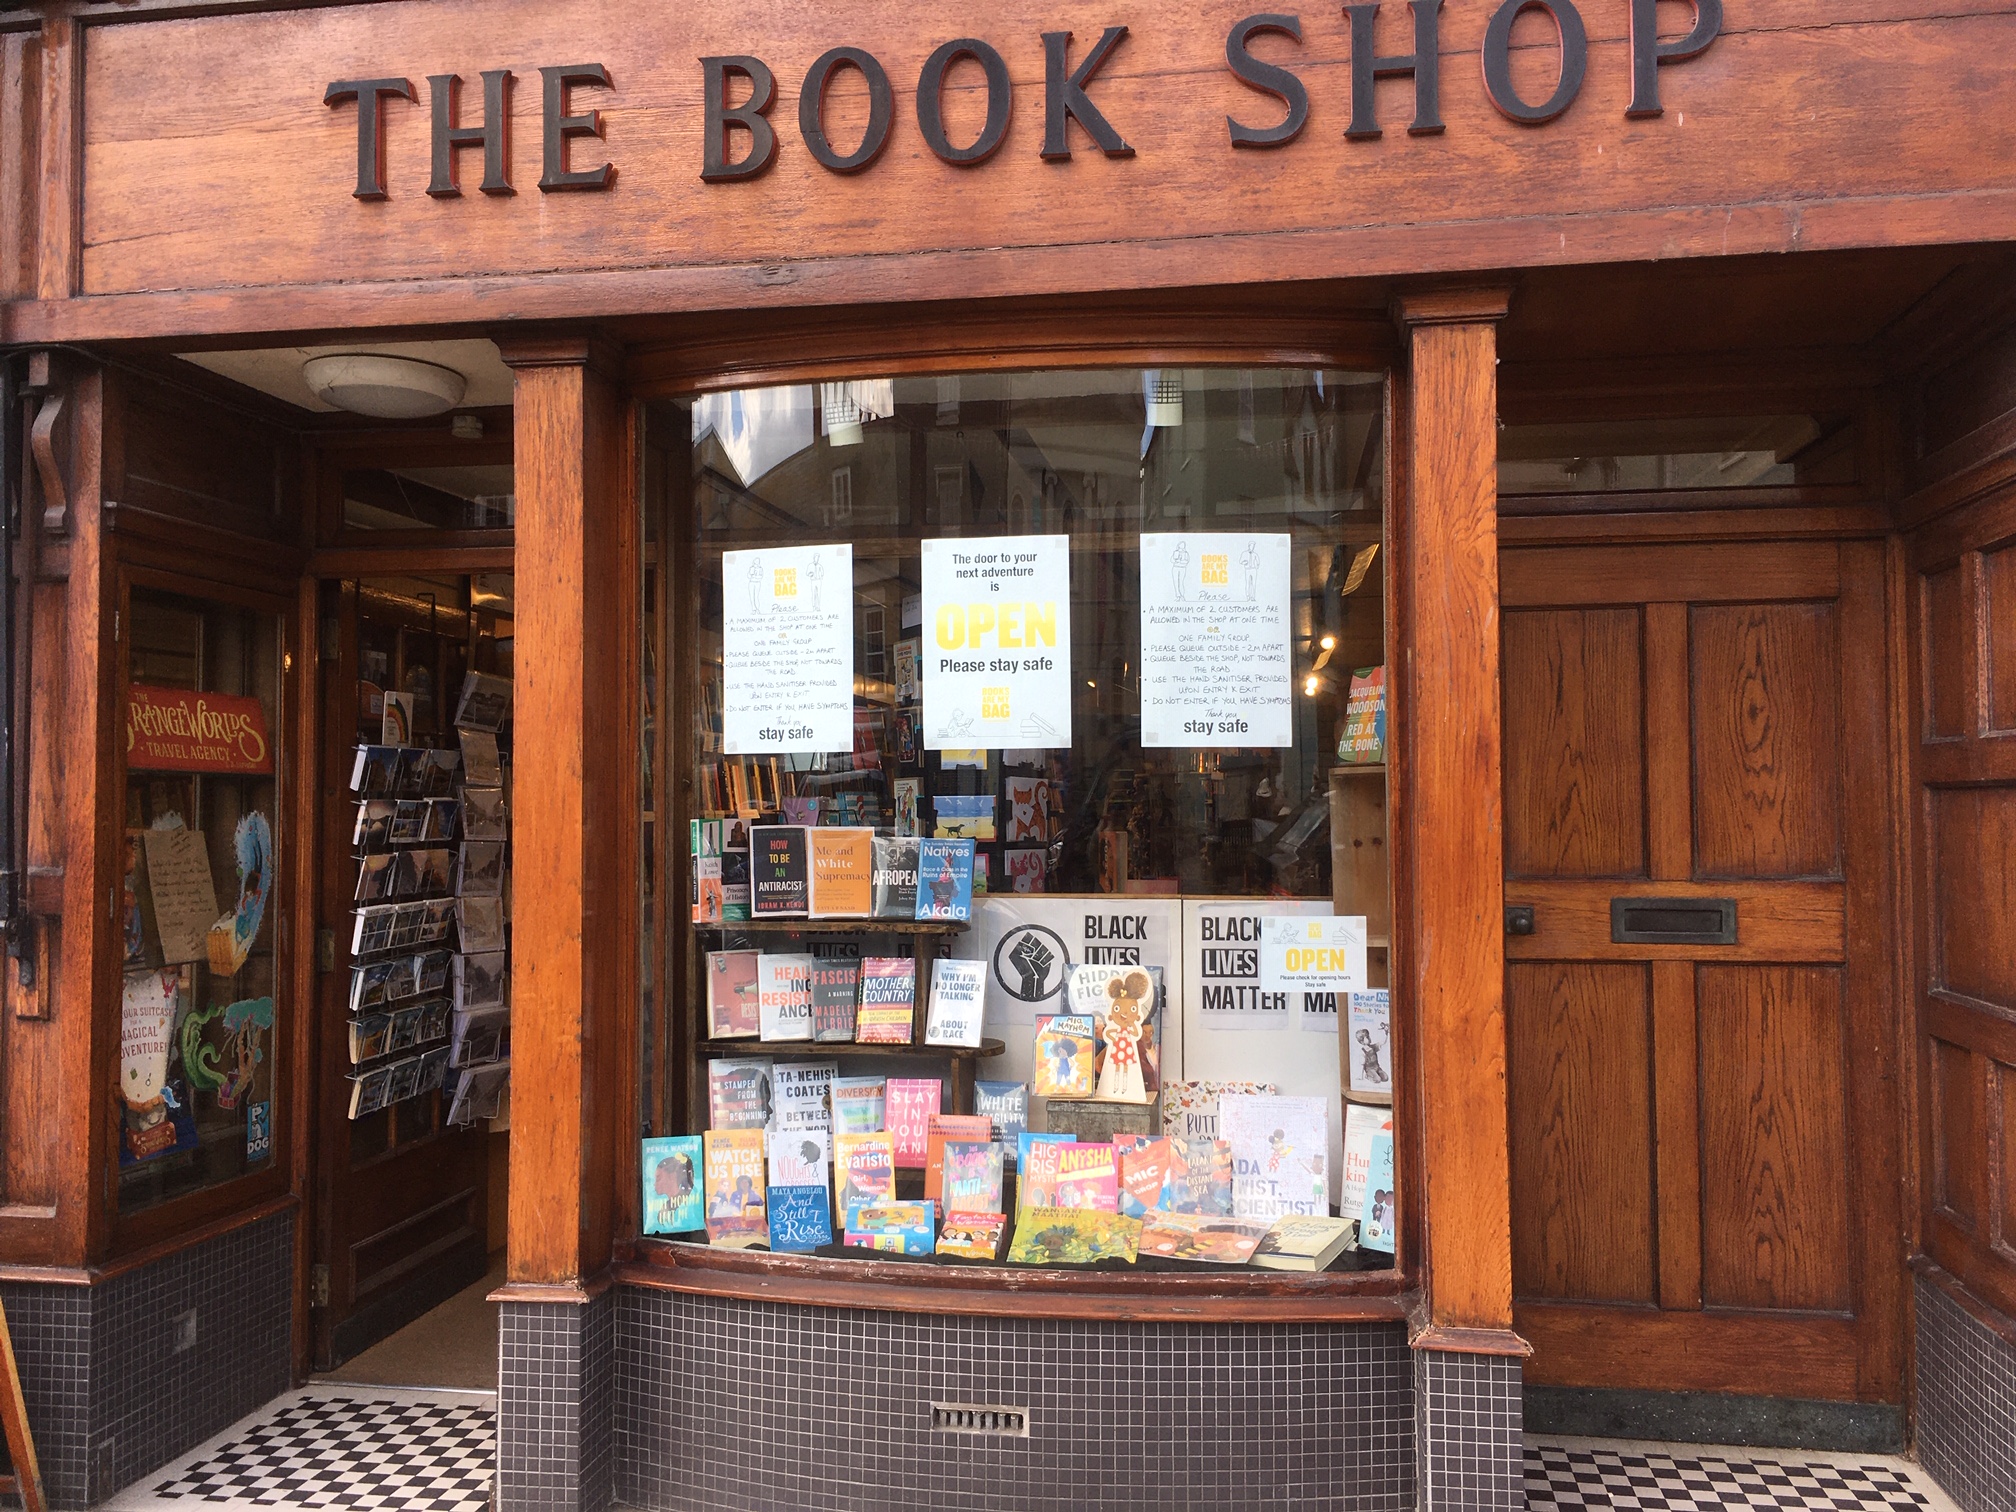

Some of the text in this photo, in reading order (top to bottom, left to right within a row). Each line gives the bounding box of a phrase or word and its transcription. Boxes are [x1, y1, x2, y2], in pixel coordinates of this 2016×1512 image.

[323, 0, 1722, 199] THE BOOK SHOP
[952, 553, 1037, 564] The door to your
[1201, 554, 1228, 563] BOOKS
[956, 567, 1034, 578] next adventure
[1201, 570, 1228, 584] BAG
[774, 582, 797, 597] BAG
[990, 581, 1000, 591] is
[1199, 590, 1230, 601] Please
[772, 603, 799, 613] Please
[1149, 605, 1154, 613] A
[1158, 605, 1193, 613] MAXIMUM
[1196, 605, 1205, 613] OF
[1209, 605, 1216, 613] 2
[1218, 605, 1260, 613] CUSTOMERS
[936, 602, 1056, 650] OPEN
[1150, 616, 1180, 624] ALLOWED
[1208, 616, 1226, 624] SHOP
[1229, 616, 1241, 624] AT
[1198, 634, 1225, 642] FAMILY
[1227, 634, 1250, 642] GROUP
[940, 657, 1053, 674] Please stay safe
[1211, 665, 1230, 673] ROAD
[1212, 675, 1252, 683] SANITISER
[1255, 675, 1288, 683] PROVIDED
[982, 687, 1010, 695] BOOKS
[1152, 697, 1163, 705] DO
[1184, 697, 1210, 705] ENTER
[1222, 697, 1237, 705] YOU
[1259, 696, 1291, 705] SYMPTOMS
[1347, 699, 1386, 714] WOODSON
[982, 703, 1010, 718] BAG
[1205, 708, 1223, 718] Thank
[759, 725, 814, 742] stay safe
[1184, 719, 1248, 735] stay safe
[1347, 722, 1377, 736] RED AT
[146, 741, 230, 761] TRAVEL AGENCY
[1339, 738, 1379, 752] THE BONE
[770, 840, 788, 850] HOW
[816, 846, 853, 855] Me and
[924, 846, 969, 857] Natives
[769, 854, 790, 863] TO BE
[816, 859, 853, 868] White
[775, 868, 785, 877] AN
[816, 871, 870, 883] Supremacy
[873, 870, 918, 885] AFROPEA
[759, 881, 802, 891] ANTIRACIST
[920, 904, 966, 917] Akala
[1085, 915, 1147, 940] BLACK
[1201, 917, 1261, 941] BLACK
[1088, 948, 1138, 966] LIVES
[1205, 950, 1256, 975] LIVES
[1285, 948, 1345, 973] OPEN
[865, 977, 909, 990] MOTHER
[942, 973, 976, 982] WHY I'M
[935, 982, 980, 992] NO LONGER
[863, 989, 910, 1003] COUNTRY
[940, 992, 974, 1000] TALKING
[1202, 985, 1285, 1010] MATTER
[779, 1003, 812, 1018] ANCE
[817, 1017, 854, 1030] ALBRIG
[940, 1020, 968, 1029] ABOUT
[121, 1026, 158, 1042] MAGICAL
[943, 1030, 964, 1038] RACE
[724, 1080, 756, 1089] STAMPED
[786, 1084, 830, 1098] COATES
[738, 1090, 756, 1099] FROM
[891, 1091, 936, 1104] SLAY
[980, 1096, 1022, 1111] WHITE
[729, 1110, 767, 1121] BEGINNING
[903, 1108, 920, 1120] IN
[888, 1125, 923, 1137] YOU
[1186, 1114, 1217, 1136] BUTT
[247, 1136, 269, 1154] DOG
[837, 1141, 890, 1153] Bernardine
[1032, 1144, 1057, 1158] HIG
[710, 1149, 760, 1165] WATCH
[837, 1153, 891, 1170] Evaristo
[708, 1163, 762, 1179] US RISE
[1030, 1160, 1055, 1174] RIS
[1030, 1174, 1055, 1182] MYSTE
[1124, 1165, 1159, 1185] MIC
[1186, 1174, 1213, 1187] DISTANT
[792, 1187, 822, 1195] ANGELOU
[858, 1184, 887, 1192] Woman,
[1134, 1181, 1159, 1195] DROP
[1194, 1186, 1208, 1197] SEA
[785, 1194, 814, 1209] And
[1234, 1199, 1315, 1216] CIENTIST
[779, 1219, 825, 1242] Rise
